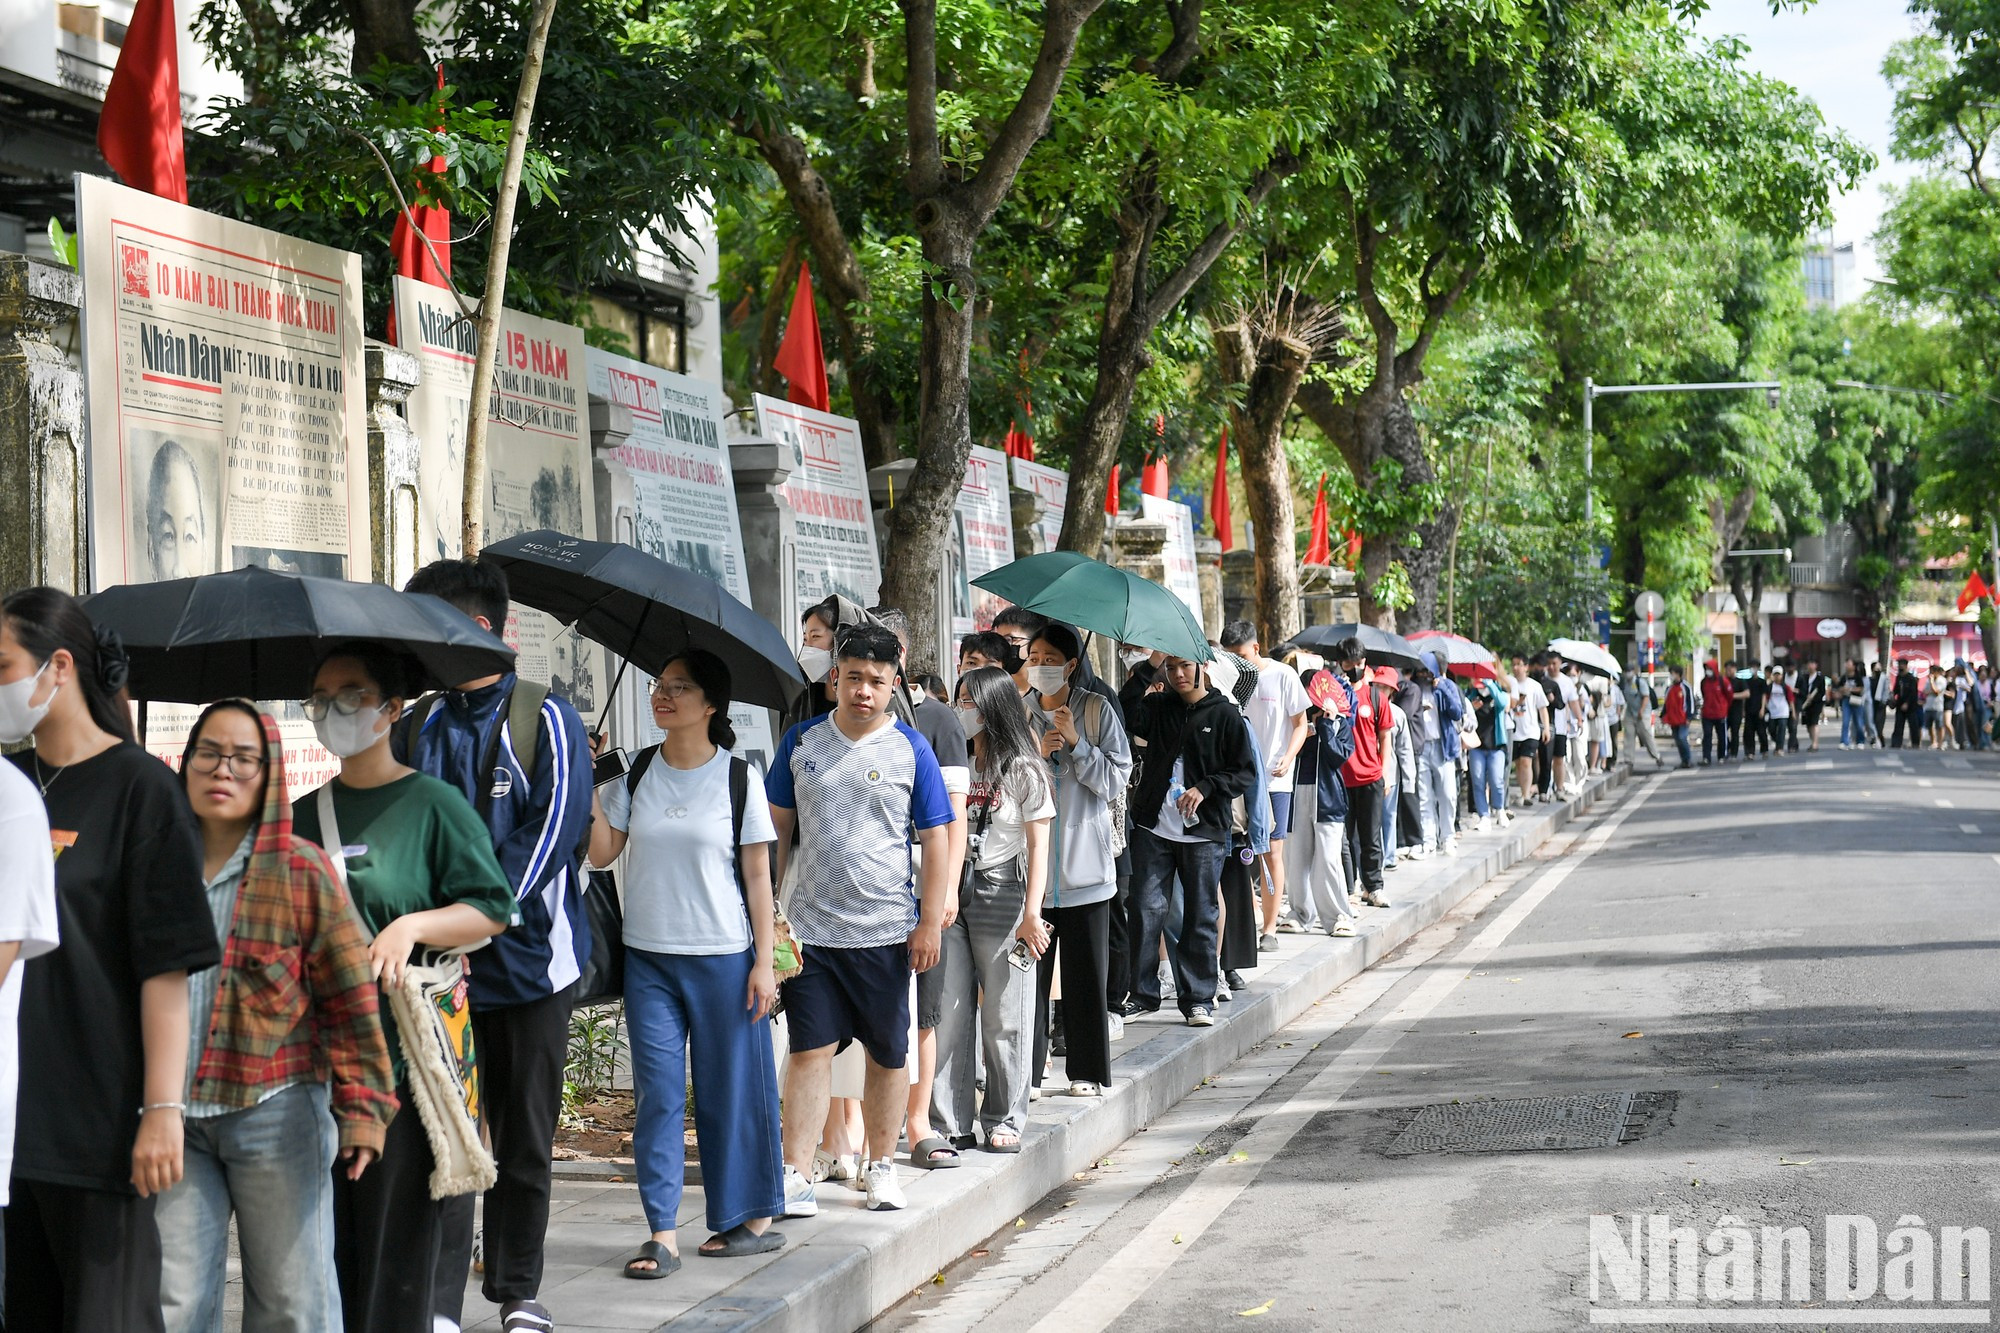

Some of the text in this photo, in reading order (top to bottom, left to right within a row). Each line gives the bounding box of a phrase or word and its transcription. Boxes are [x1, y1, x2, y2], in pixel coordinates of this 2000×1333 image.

[175, 266, 202, 304] NĂM
[207, 274, 229, 315] ĐẠI
[306, 301, 336, 335] XUÂN
[418, 300, 454, 350] Nhân
[140, 322, 222, 384] Nhân Dân
[309, 361, 323, 390] HÀ
[506, 330, 528, 370] 15
[530, 337, 569, 381] NĂM
